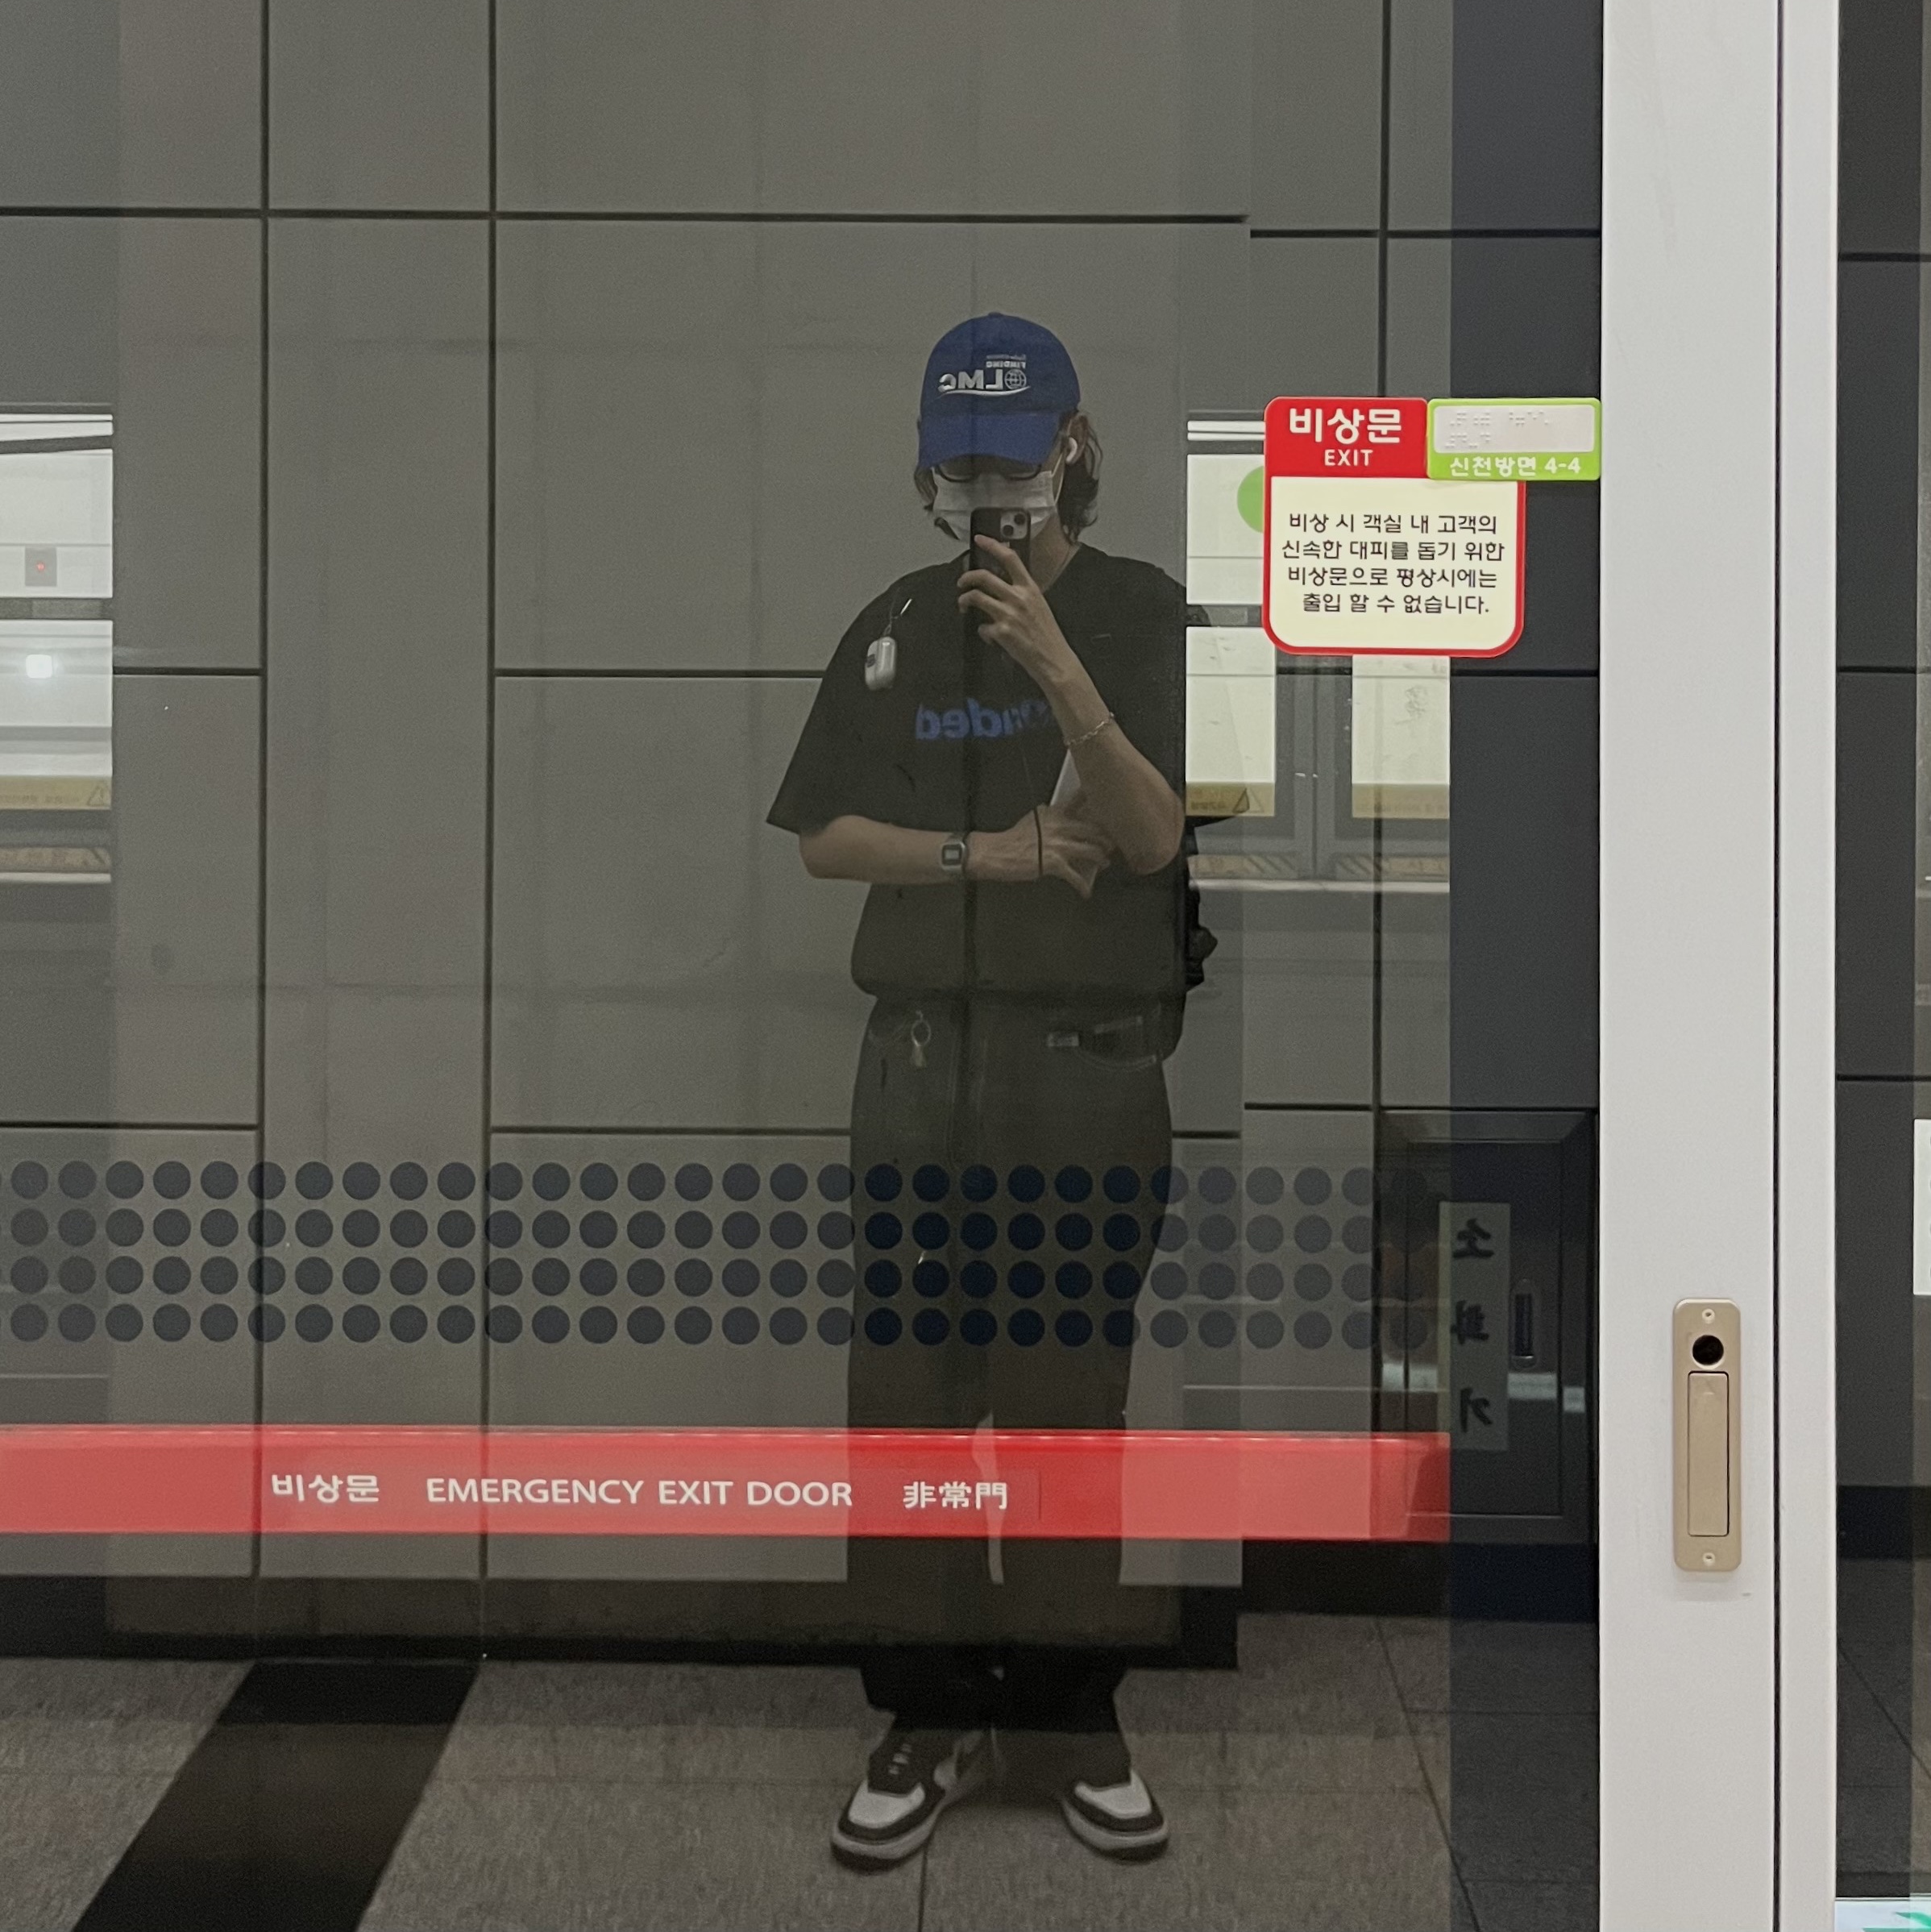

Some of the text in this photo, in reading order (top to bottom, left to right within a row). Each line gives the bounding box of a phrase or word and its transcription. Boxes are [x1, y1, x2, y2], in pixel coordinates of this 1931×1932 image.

[1290, 408, 1402, 445] 비상문
[1324, 449, 1373, 467] EXIT
[1450, 456, 1581, 477] 신천방면 4-4
[1289, 513, 1497, 535] 비상 시 객실 내 고객의
[1281, 539, 1505, 562] 신속한 대피를 돕기 위한
[1288, 567, 1497, 588] 비상문으로 평상시에는
[1303, 593, 1489, 615] 출입 할 수 없습니다.
[272, 1474, 380, 1504] 비상문
[426, 1477, 853, 1506] EMERGENCY EXIT DOOR
[903, 1481, 1008, 1510] 非常門
